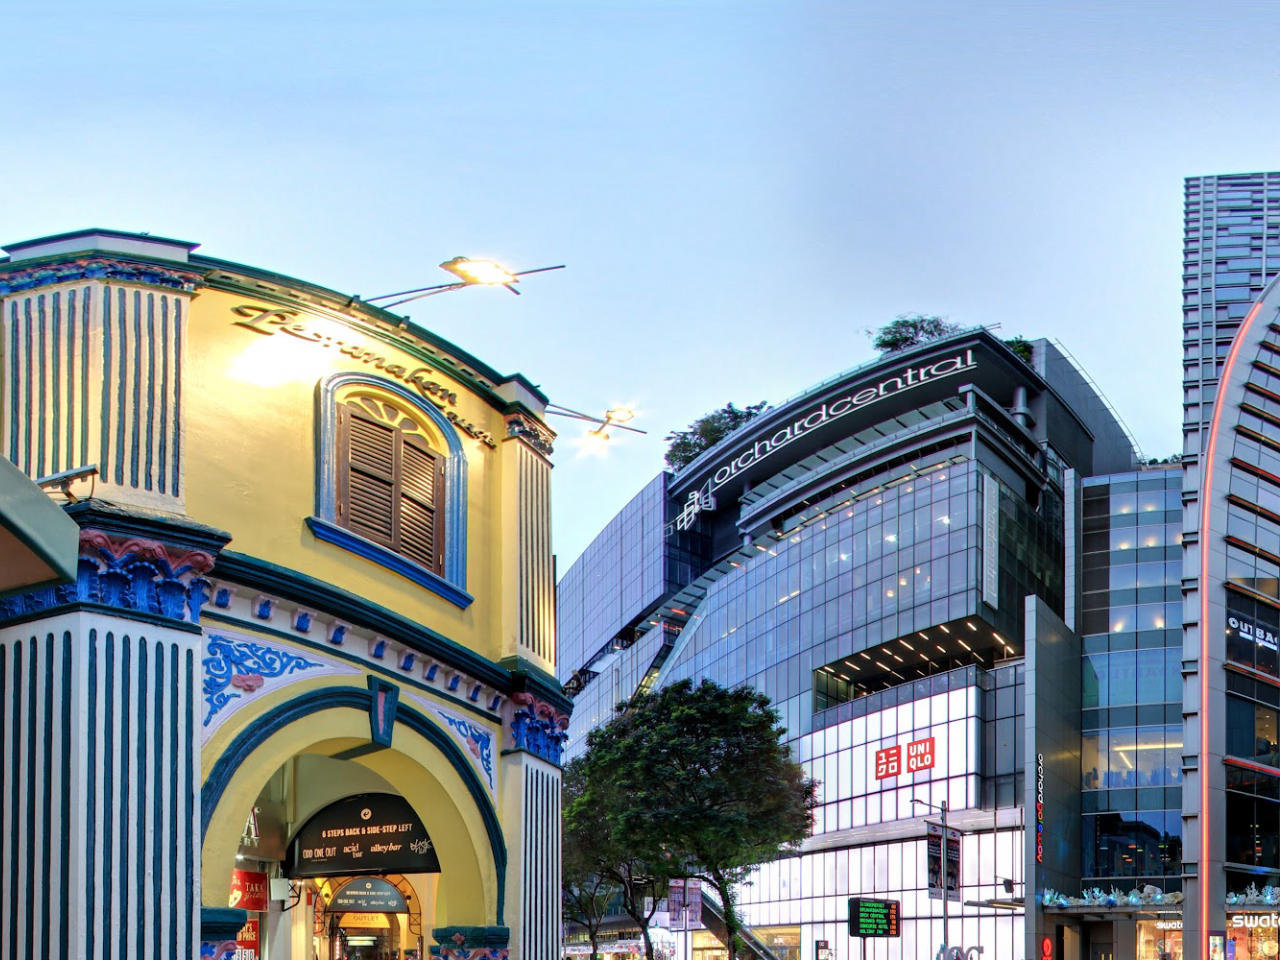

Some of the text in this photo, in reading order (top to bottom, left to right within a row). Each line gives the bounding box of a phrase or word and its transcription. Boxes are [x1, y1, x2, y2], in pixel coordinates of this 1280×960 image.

[714, 349, 976, 485] orchardcentral
[327, 829, 344, 838] STEPS
[345, 827, 360, 836] BACK
[367, 824, 397, 835] SIDE-STEP
[398, 823, 413, 832] LEFT
[325, 847, 337, 858] OUT
